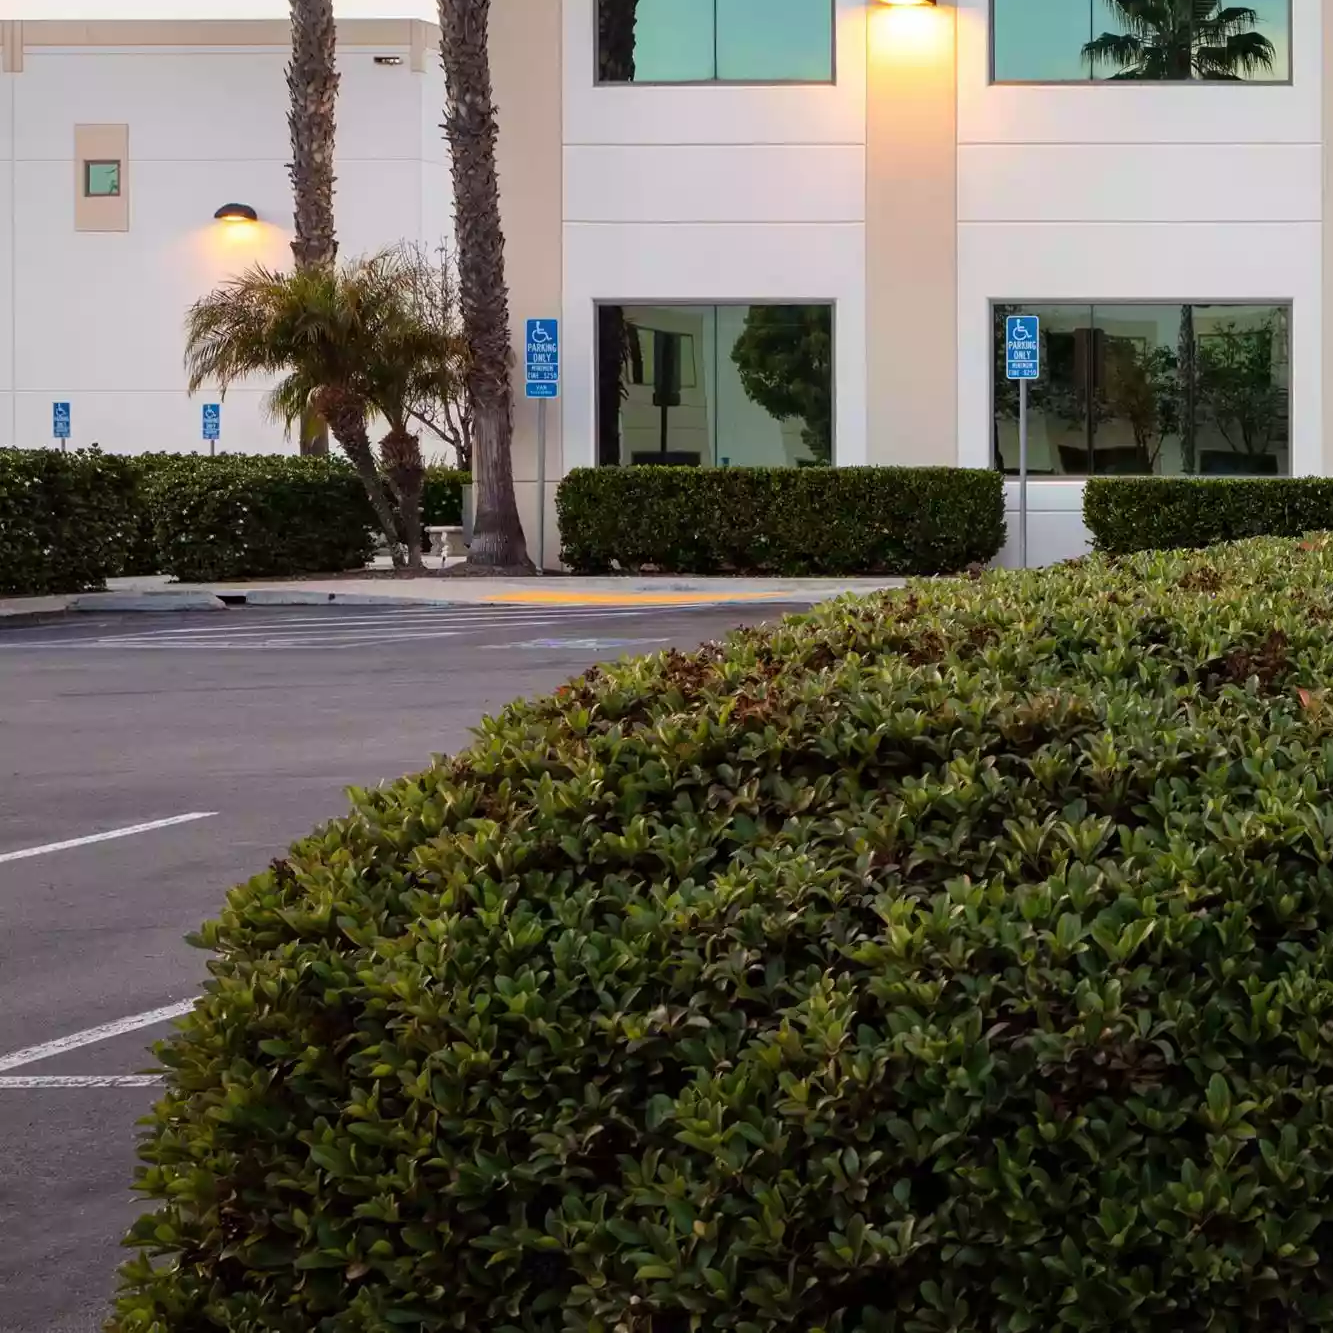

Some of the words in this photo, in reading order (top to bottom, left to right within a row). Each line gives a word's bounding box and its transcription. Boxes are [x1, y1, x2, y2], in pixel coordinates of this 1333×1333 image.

[528, 343, 557, 352] PARKING
[533, 353, 551, 363] ONLY
[1013, 350, 1031, 360] ONLY
